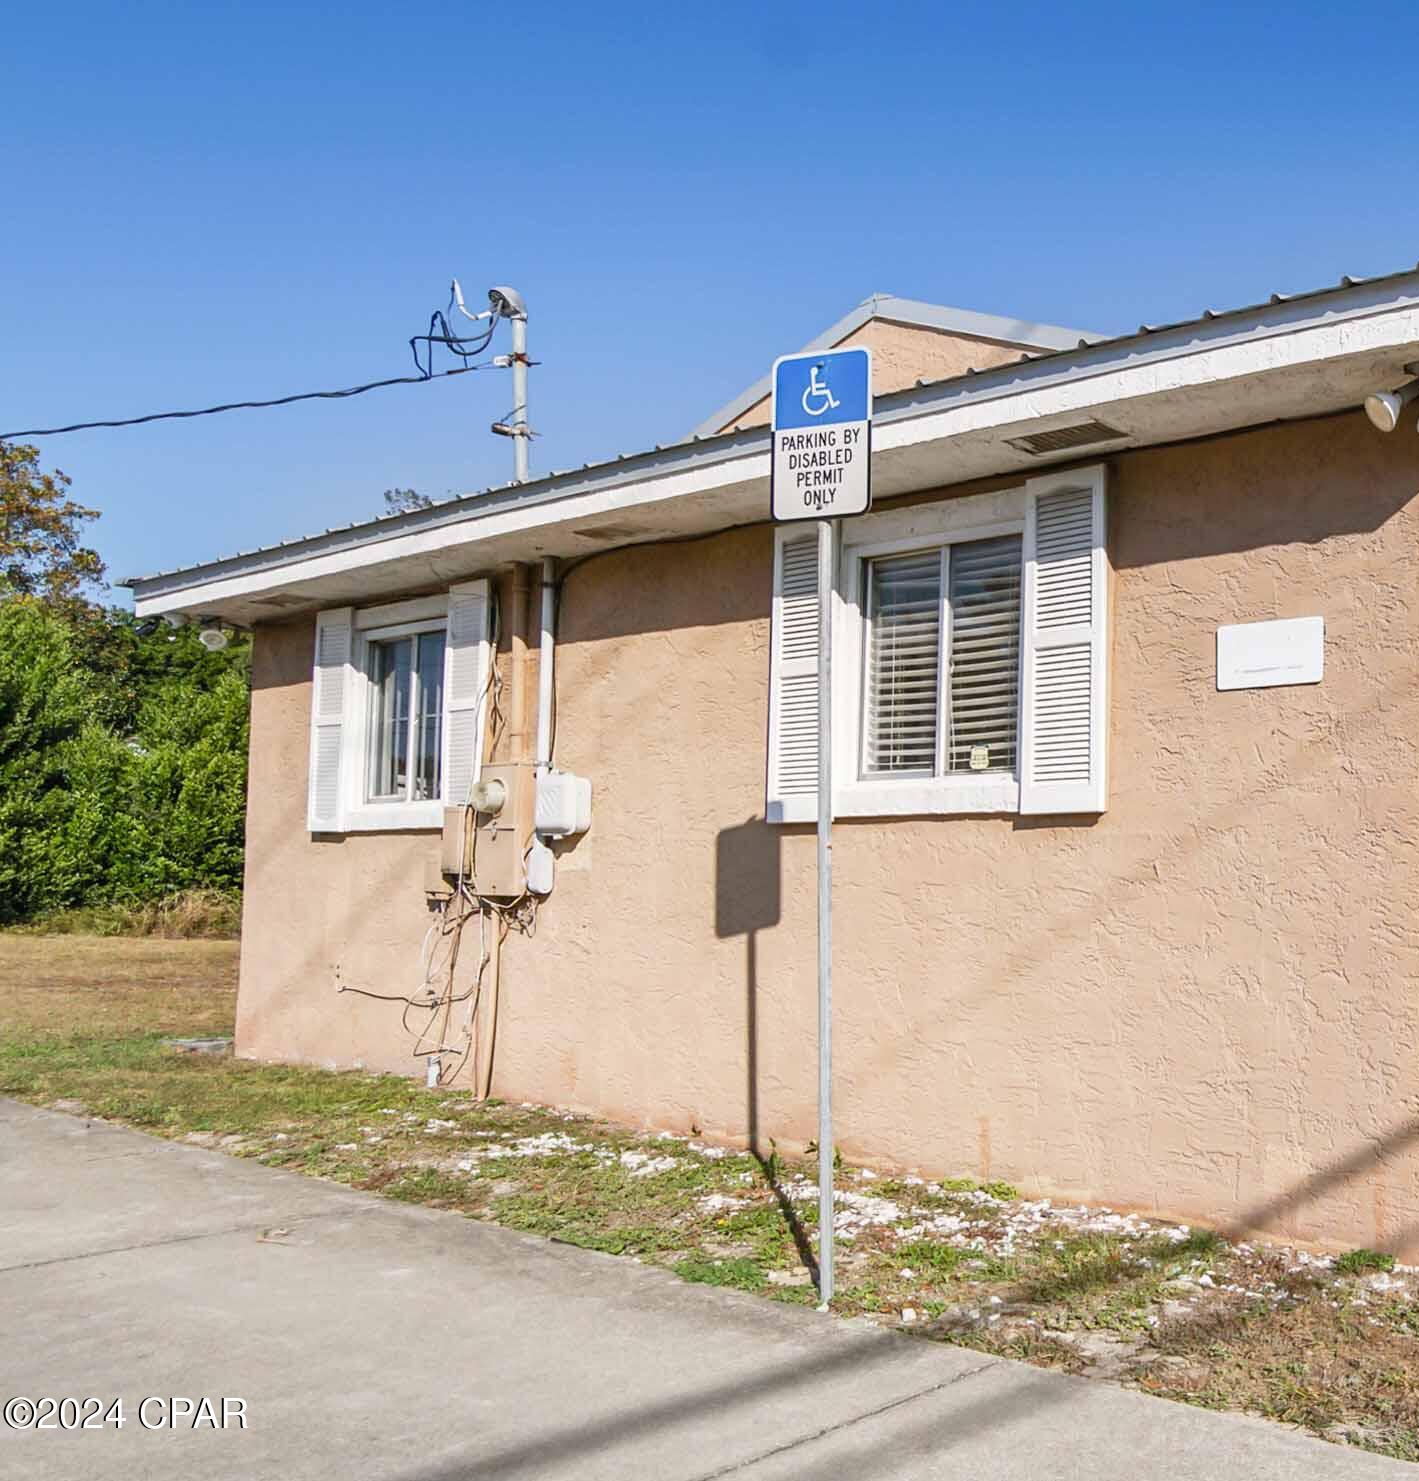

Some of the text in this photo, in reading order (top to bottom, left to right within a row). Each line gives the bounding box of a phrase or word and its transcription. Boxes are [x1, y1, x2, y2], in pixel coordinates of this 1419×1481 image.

[781, 427, 860, 452] PARKING BY
[789, 448, 853, 470] DISABLED
[796, 467, 844, 488] PERMIT
[804, 487, 837, 506] ONLY
